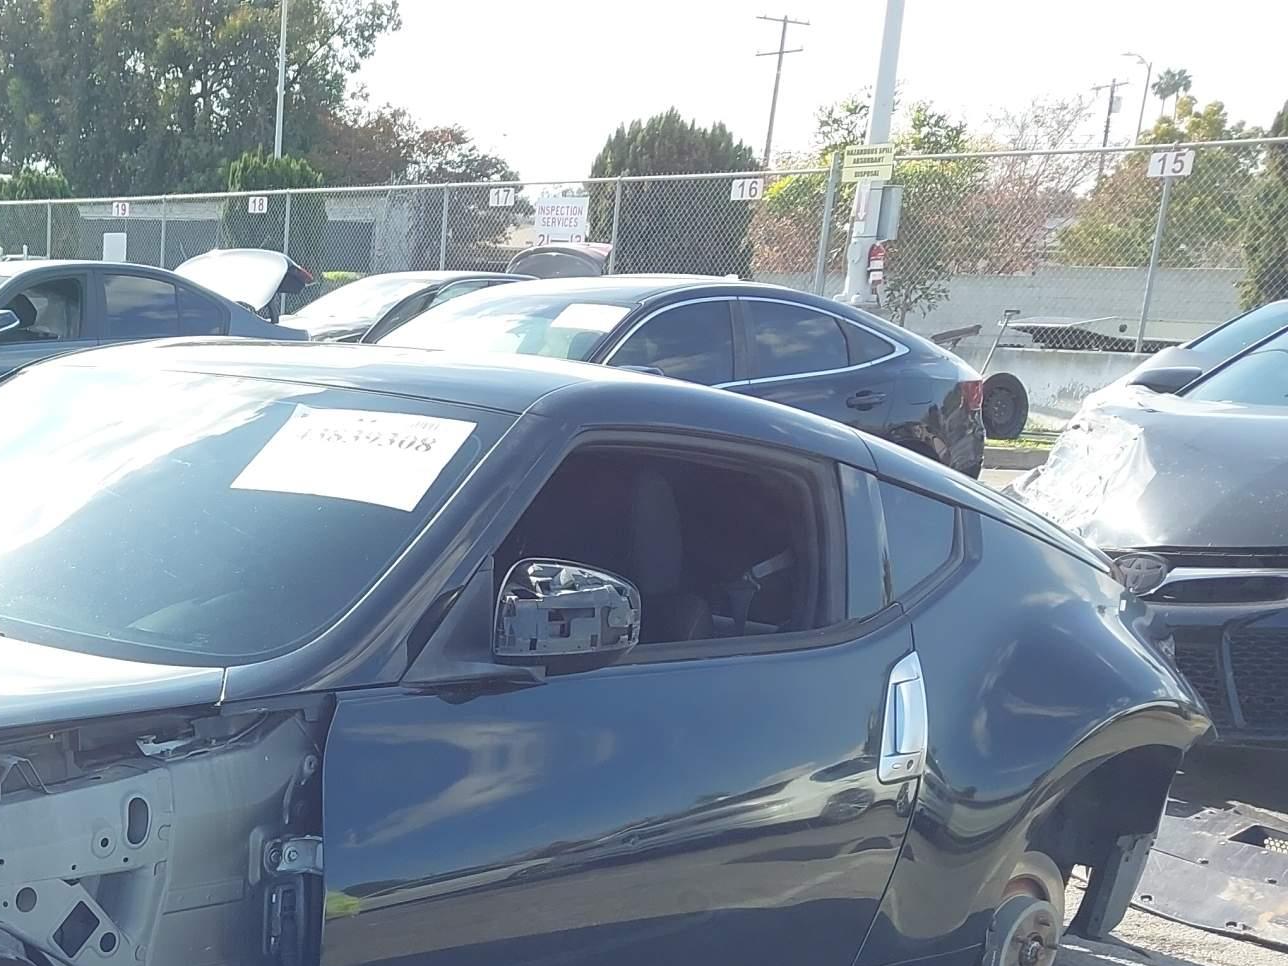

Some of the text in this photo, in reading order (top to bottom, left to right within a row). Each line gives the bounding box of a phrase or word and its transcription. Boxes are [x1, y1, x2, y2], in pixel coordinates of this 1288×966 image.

[1158, 153, 1186, 175] 15
[738, 181, 758, 198] 16
[252, 197, 264, 211] 18
[495, 190, 510, 205] 17
[114, 203, 127, 215] 19
[538, 205, 584, 216] INSPECTION
[542, 217, 579, 228] SERVICES
